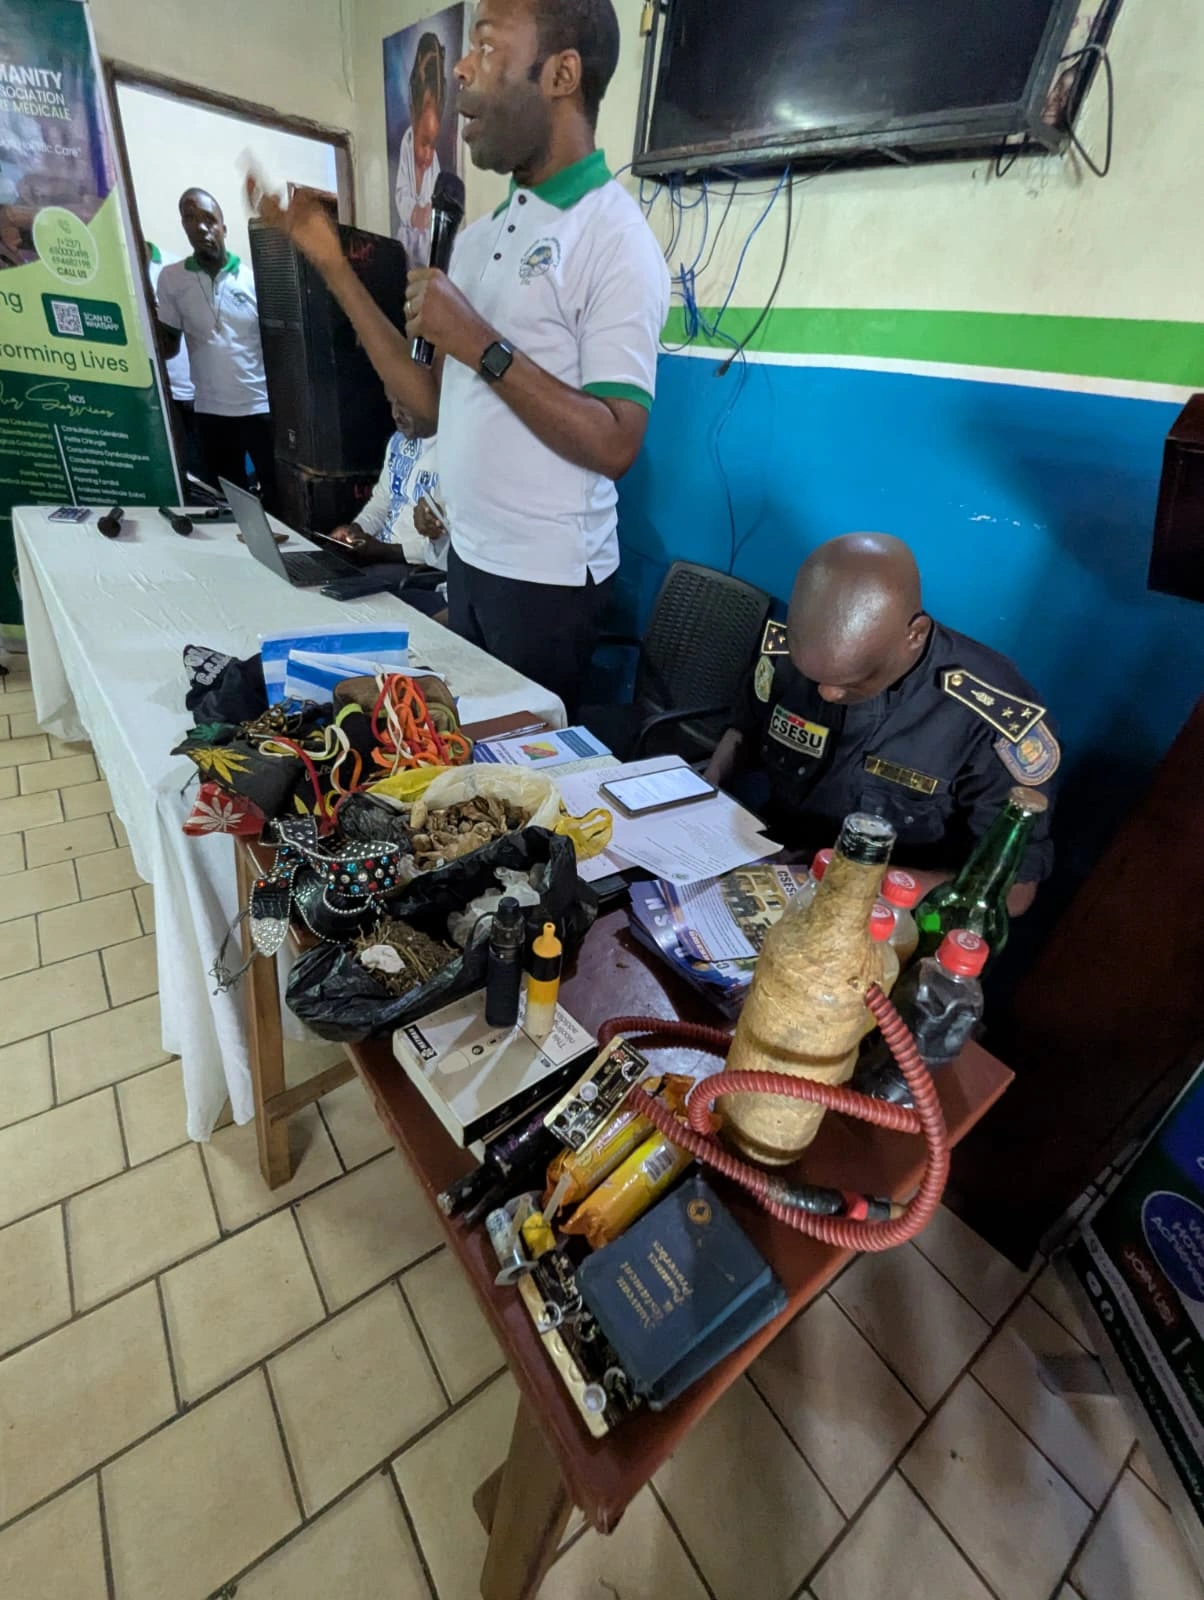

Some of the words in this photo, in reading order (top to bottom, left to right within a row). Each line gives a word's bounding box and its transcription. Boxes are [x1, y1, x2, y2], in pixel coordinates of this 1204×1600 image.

[81, 350, 129, 373] Lives
[772, 715, 823, 748] CSESU
[1124, 1248, 1157, 1294] JOIN
